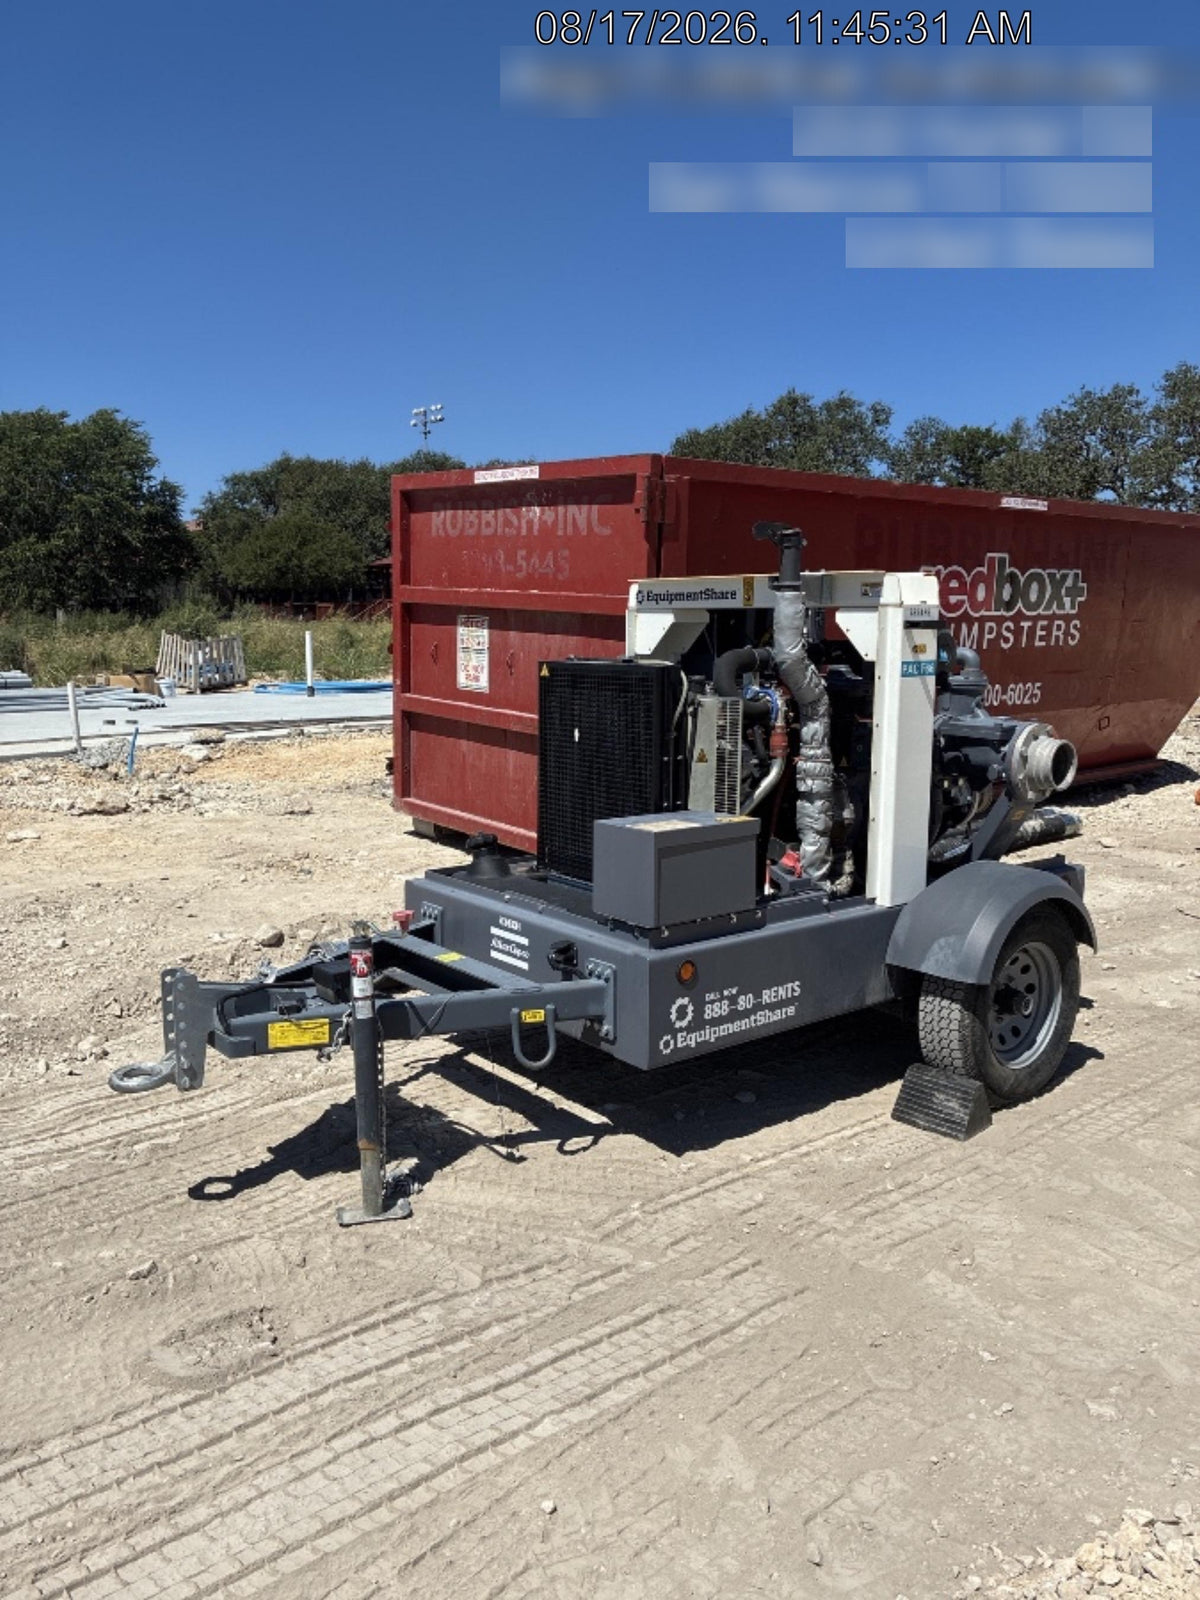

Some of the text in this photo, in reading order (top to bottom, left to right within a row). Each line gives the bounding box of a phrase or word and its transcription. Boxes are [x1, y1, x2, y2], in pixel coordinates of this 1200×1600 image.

[646, 588, 738, 604] EquipmentShare
[704, 980, 801, 1019] 888-80-RENTS
[676, 1003, 796, 1048] EquipmentShare
